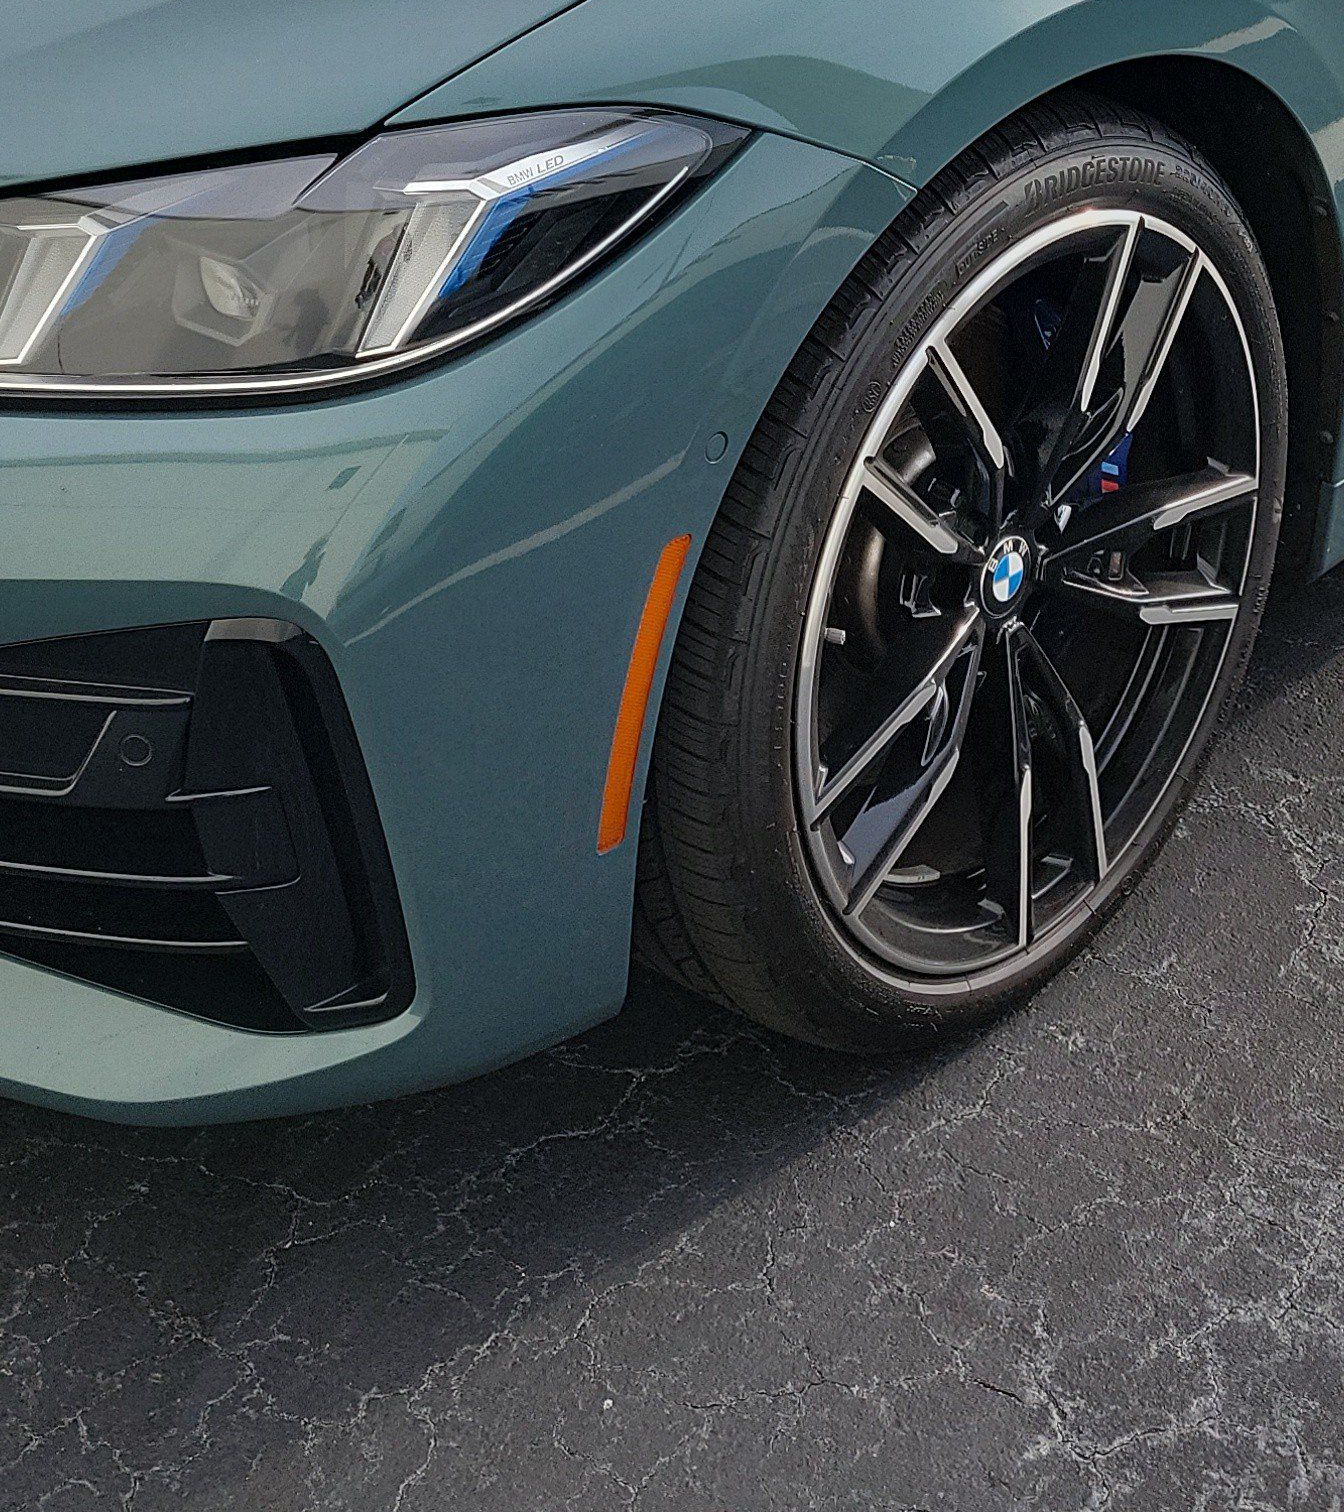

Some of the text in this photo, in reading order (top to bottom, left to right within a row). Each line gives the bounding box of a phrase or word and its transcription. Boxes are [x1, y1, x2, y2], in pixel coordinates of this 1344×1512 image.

[507, 155, 564, 185] BMW LED
[1023, 155, 1166, 217] BRIDGESTONE
[988, 539, 1029, 573] BMW
